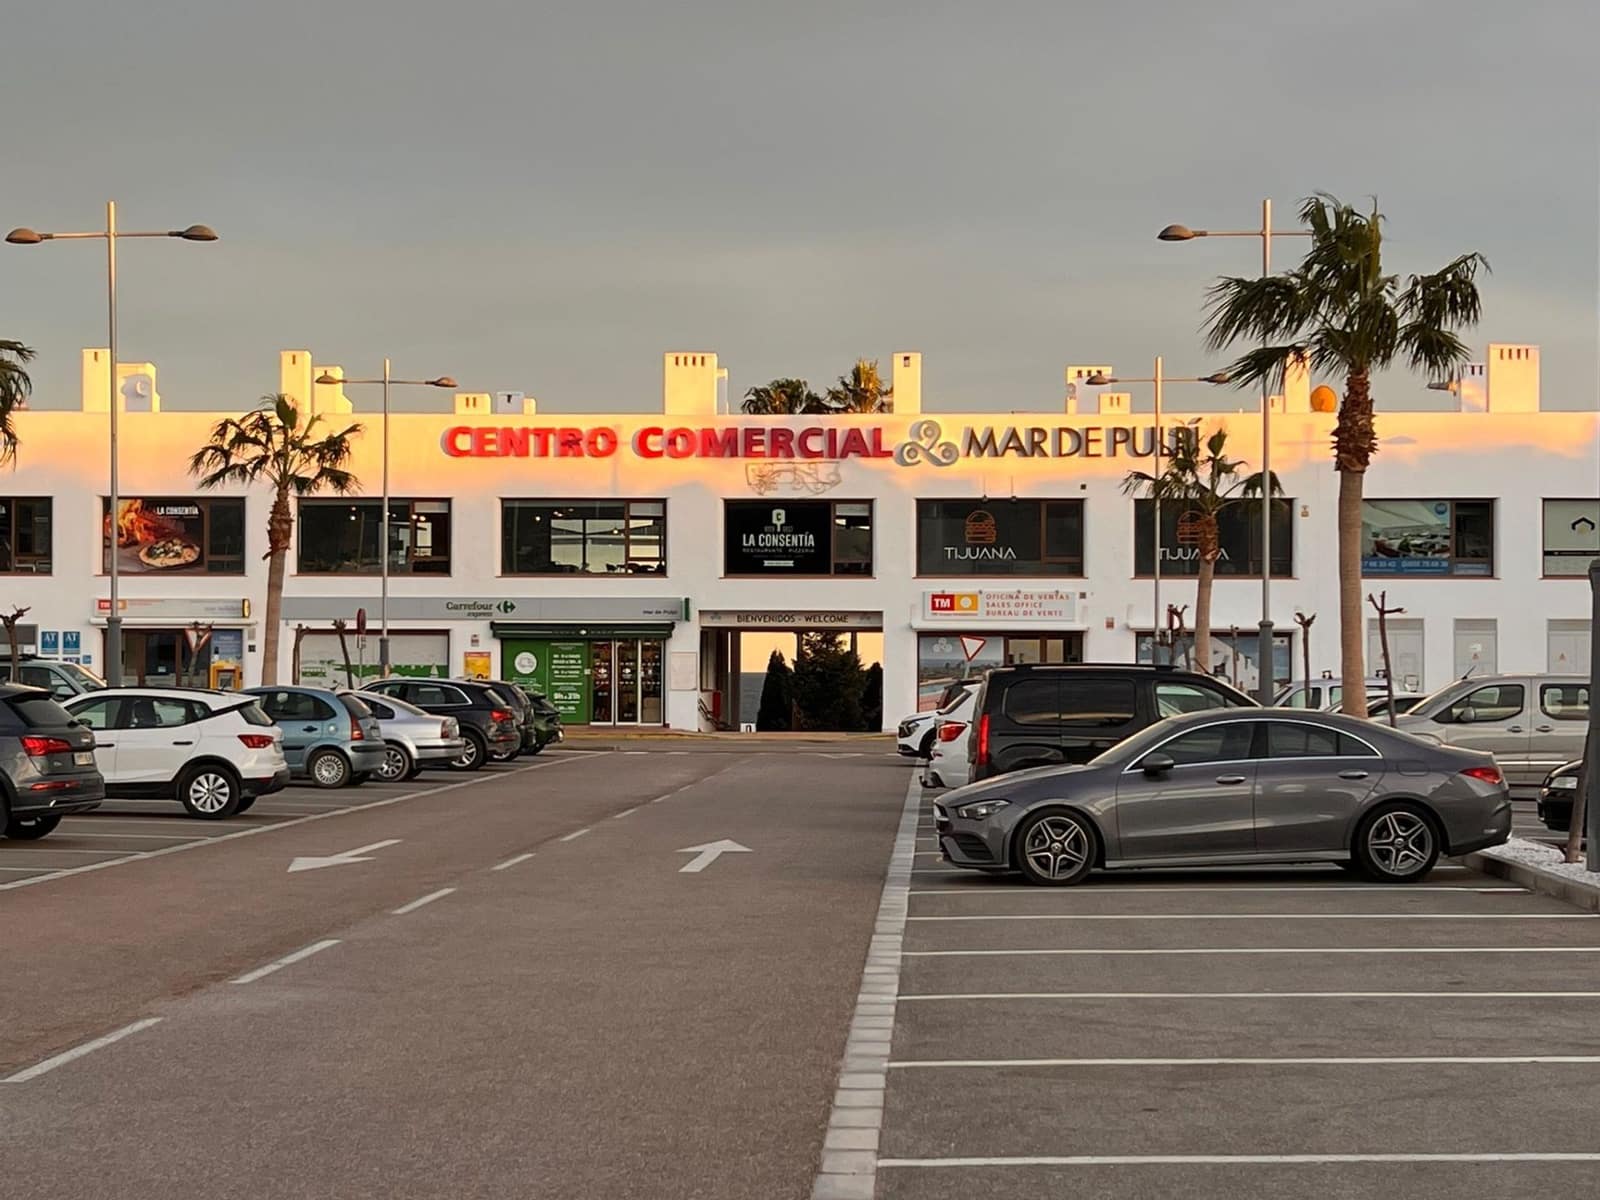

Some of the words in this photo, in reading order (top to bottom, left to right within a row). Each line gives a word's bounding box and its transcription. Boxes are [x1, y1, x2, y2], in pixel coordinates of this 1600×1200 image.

[442, 426, 618, 458] CENTRO
[633, 426, 893, 458] COMERCIAL
[742, 533, 756, 547] LA
[758, 531, 815, 547] CONSENTÍA
[944, 547, 1017, 559] TIJUANA
[1159, 548, 1230, 560] TIJUAA
[446, 601, 493, 610] Carrefour
[934, 598, 951, 608] TM
[737, 615, 796, 623] BIENVENIDOS
[804, 615, 849, 623] WELCOME
